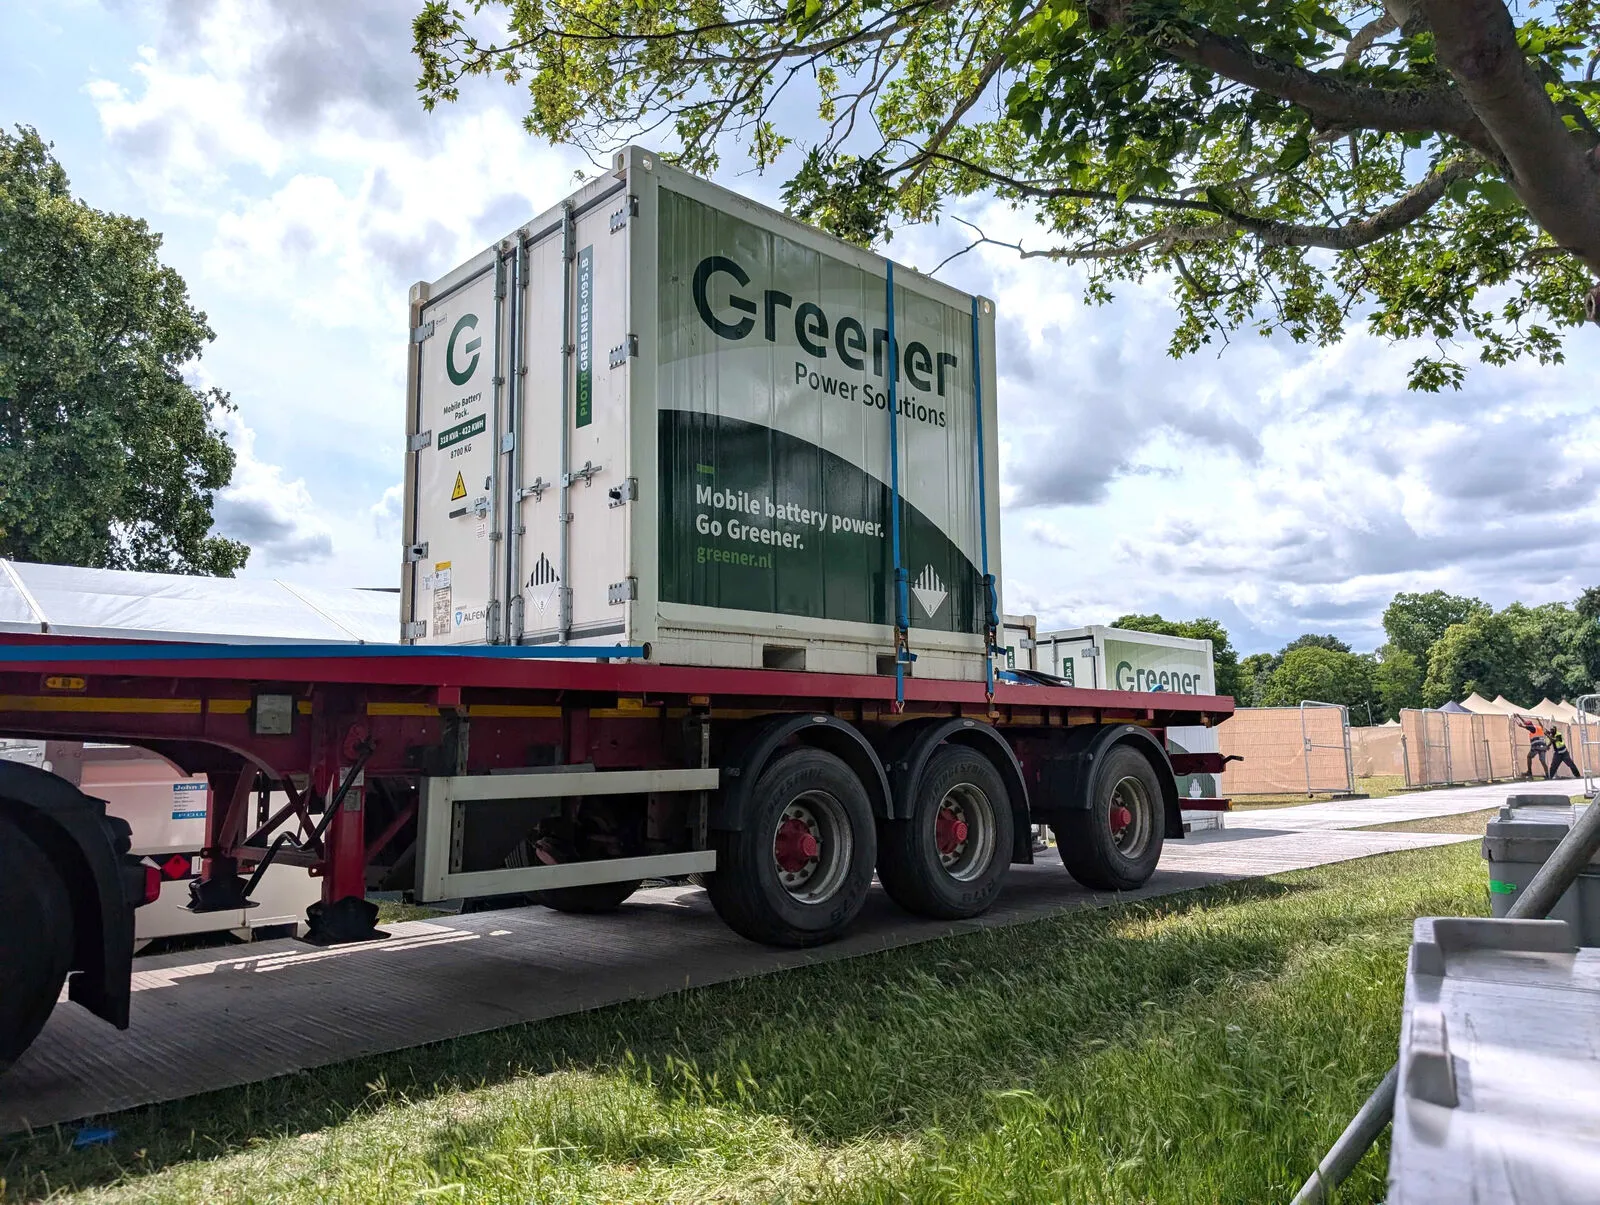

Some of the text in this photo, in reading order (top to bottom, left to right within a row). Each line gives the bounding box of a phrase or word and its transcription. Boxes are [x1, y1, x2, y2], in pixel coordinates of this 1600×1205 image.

[692, 255, 958, 397] Greener
[795, 361, 858, 402] Power
[443, 392, 482, 415] Mobile Battery
[454, 408, 470, 420] Pack.
[462, 425, 471, 435] 422
[464, 443, 472, 454] KG
[696, 483, 885, 538] Mobile battery power.
[695, 513, 804, 550] Go Greener.
[696, 546, 772, 569] greener.nl
[463, 610, 486, 622] ALFEN
[1115, 660, 1201, 695] Greener
